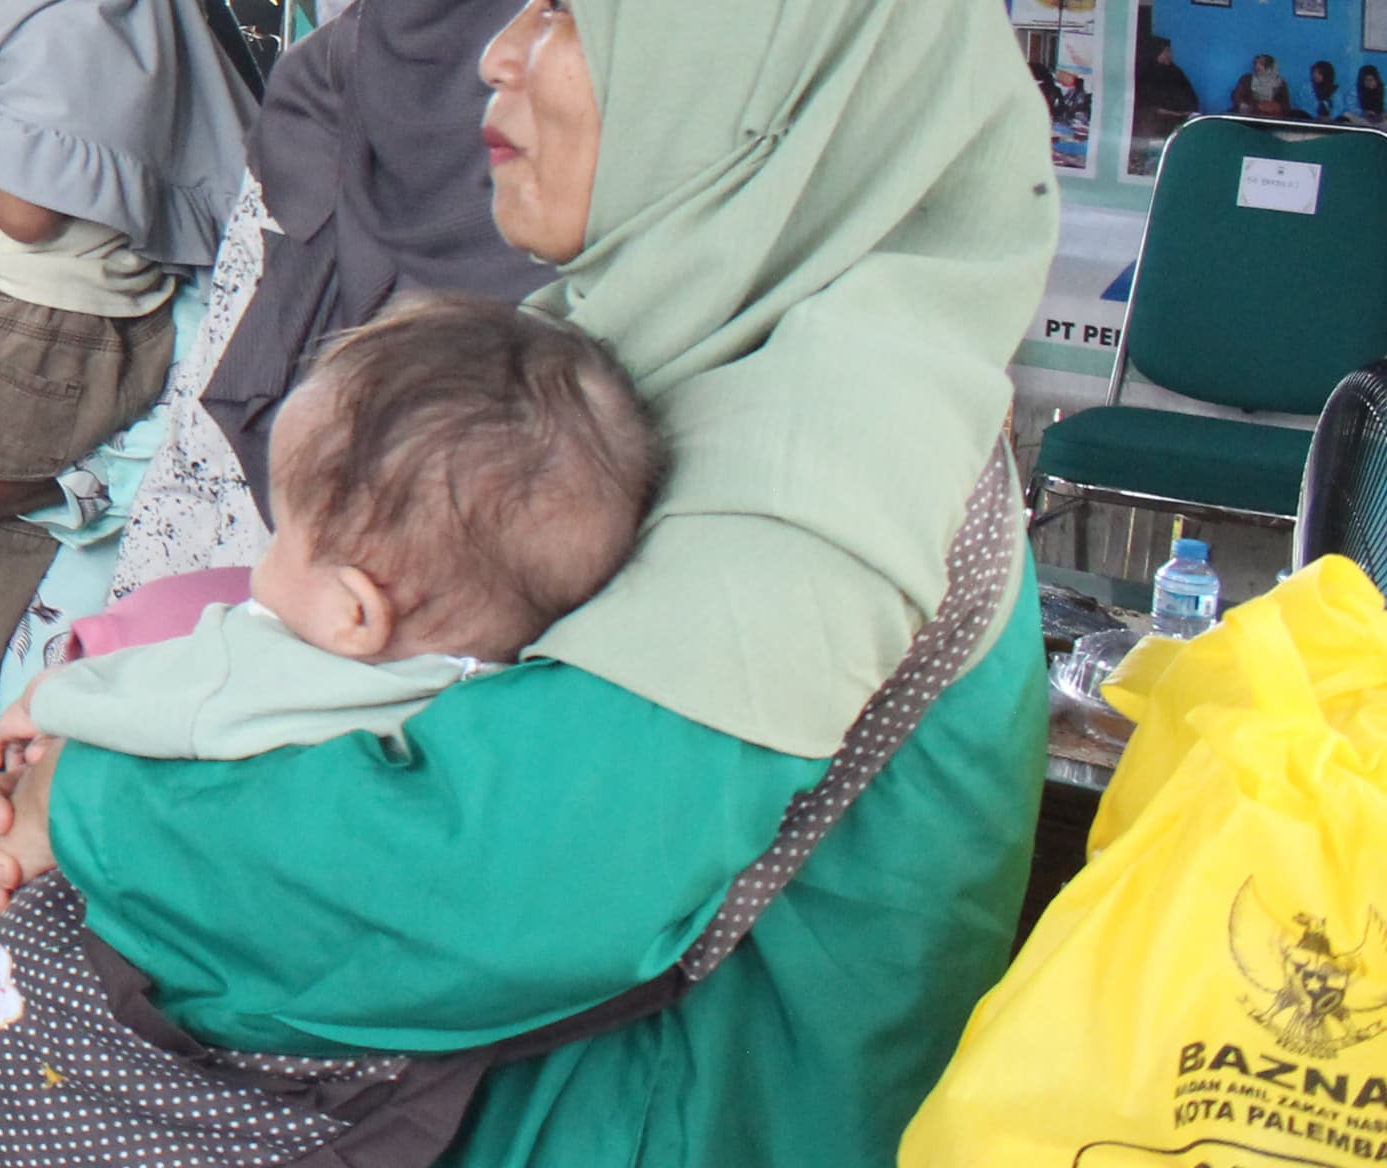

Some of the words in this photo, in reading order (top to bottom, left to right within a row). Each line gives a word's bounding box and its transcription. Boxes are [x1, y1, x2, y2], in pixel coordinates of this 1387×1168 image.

[1045, 319, 1075, 340] PT
[1174, 1098, 1235, 1130] KOTA
[1226, 1081, 1272, 1103] AMIL
[1278, 1095, 1340, 1121] ZAKAT
